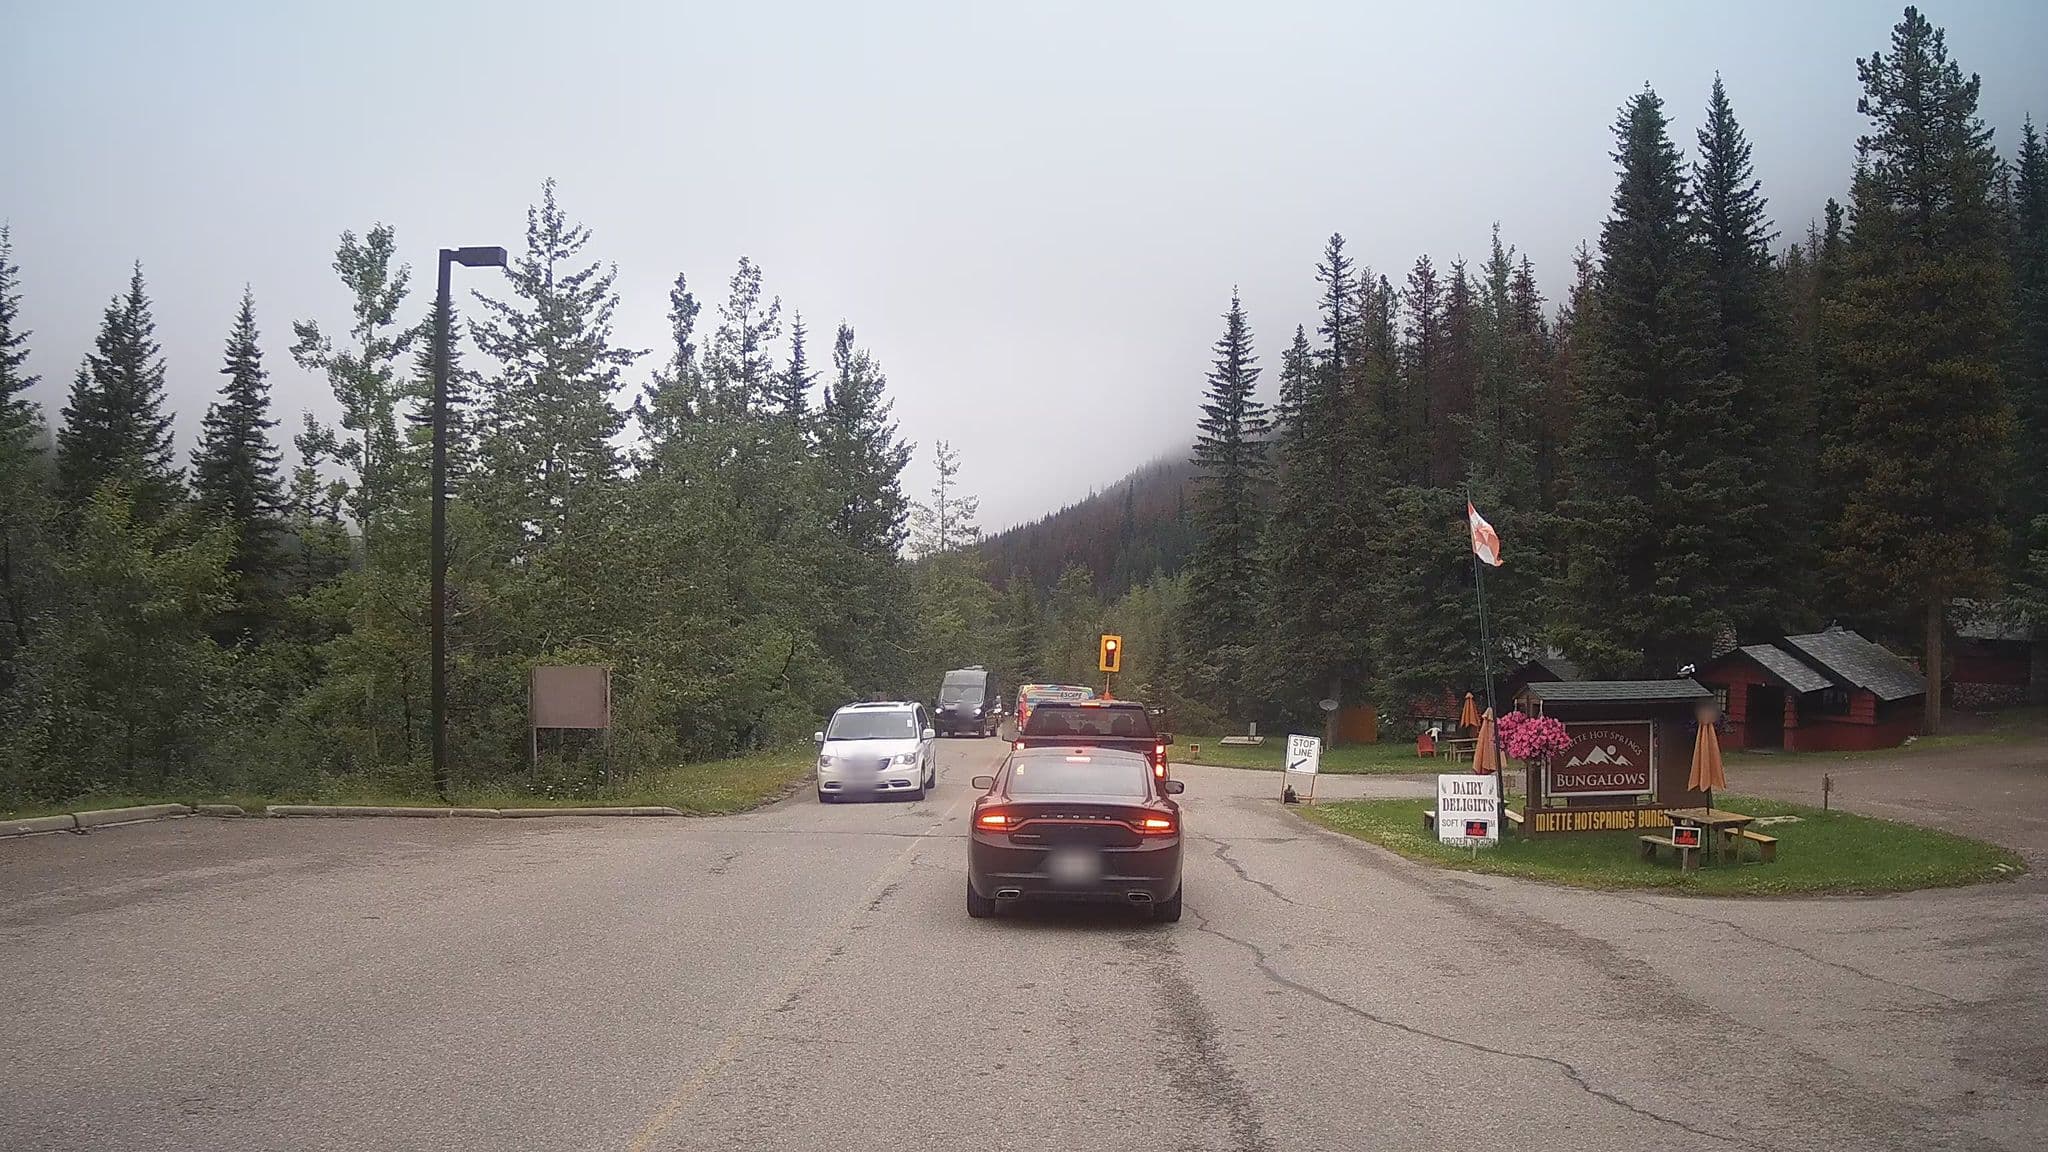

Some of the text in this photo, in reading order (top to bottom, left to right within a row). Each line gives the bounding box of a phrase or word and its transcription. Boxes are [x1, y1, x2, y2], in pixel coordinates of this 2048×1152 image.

[1293, 738, 1316, 748] STOP
[1590, 730, 1609, 740] HOT
[1610, 731, 1643, 756] SPRINGS
[1293, 747, 1313, 758] LINE
[1557, 773, 1646, 788] BUNGALOWS
[1453, 781, 1484, 795] DAIRY
[1442, 797, 1495, 812] DELIGHTS
[1441, 818, 1459, 827] SOFT
[1535, 812, 1573, 832] MIETTE
